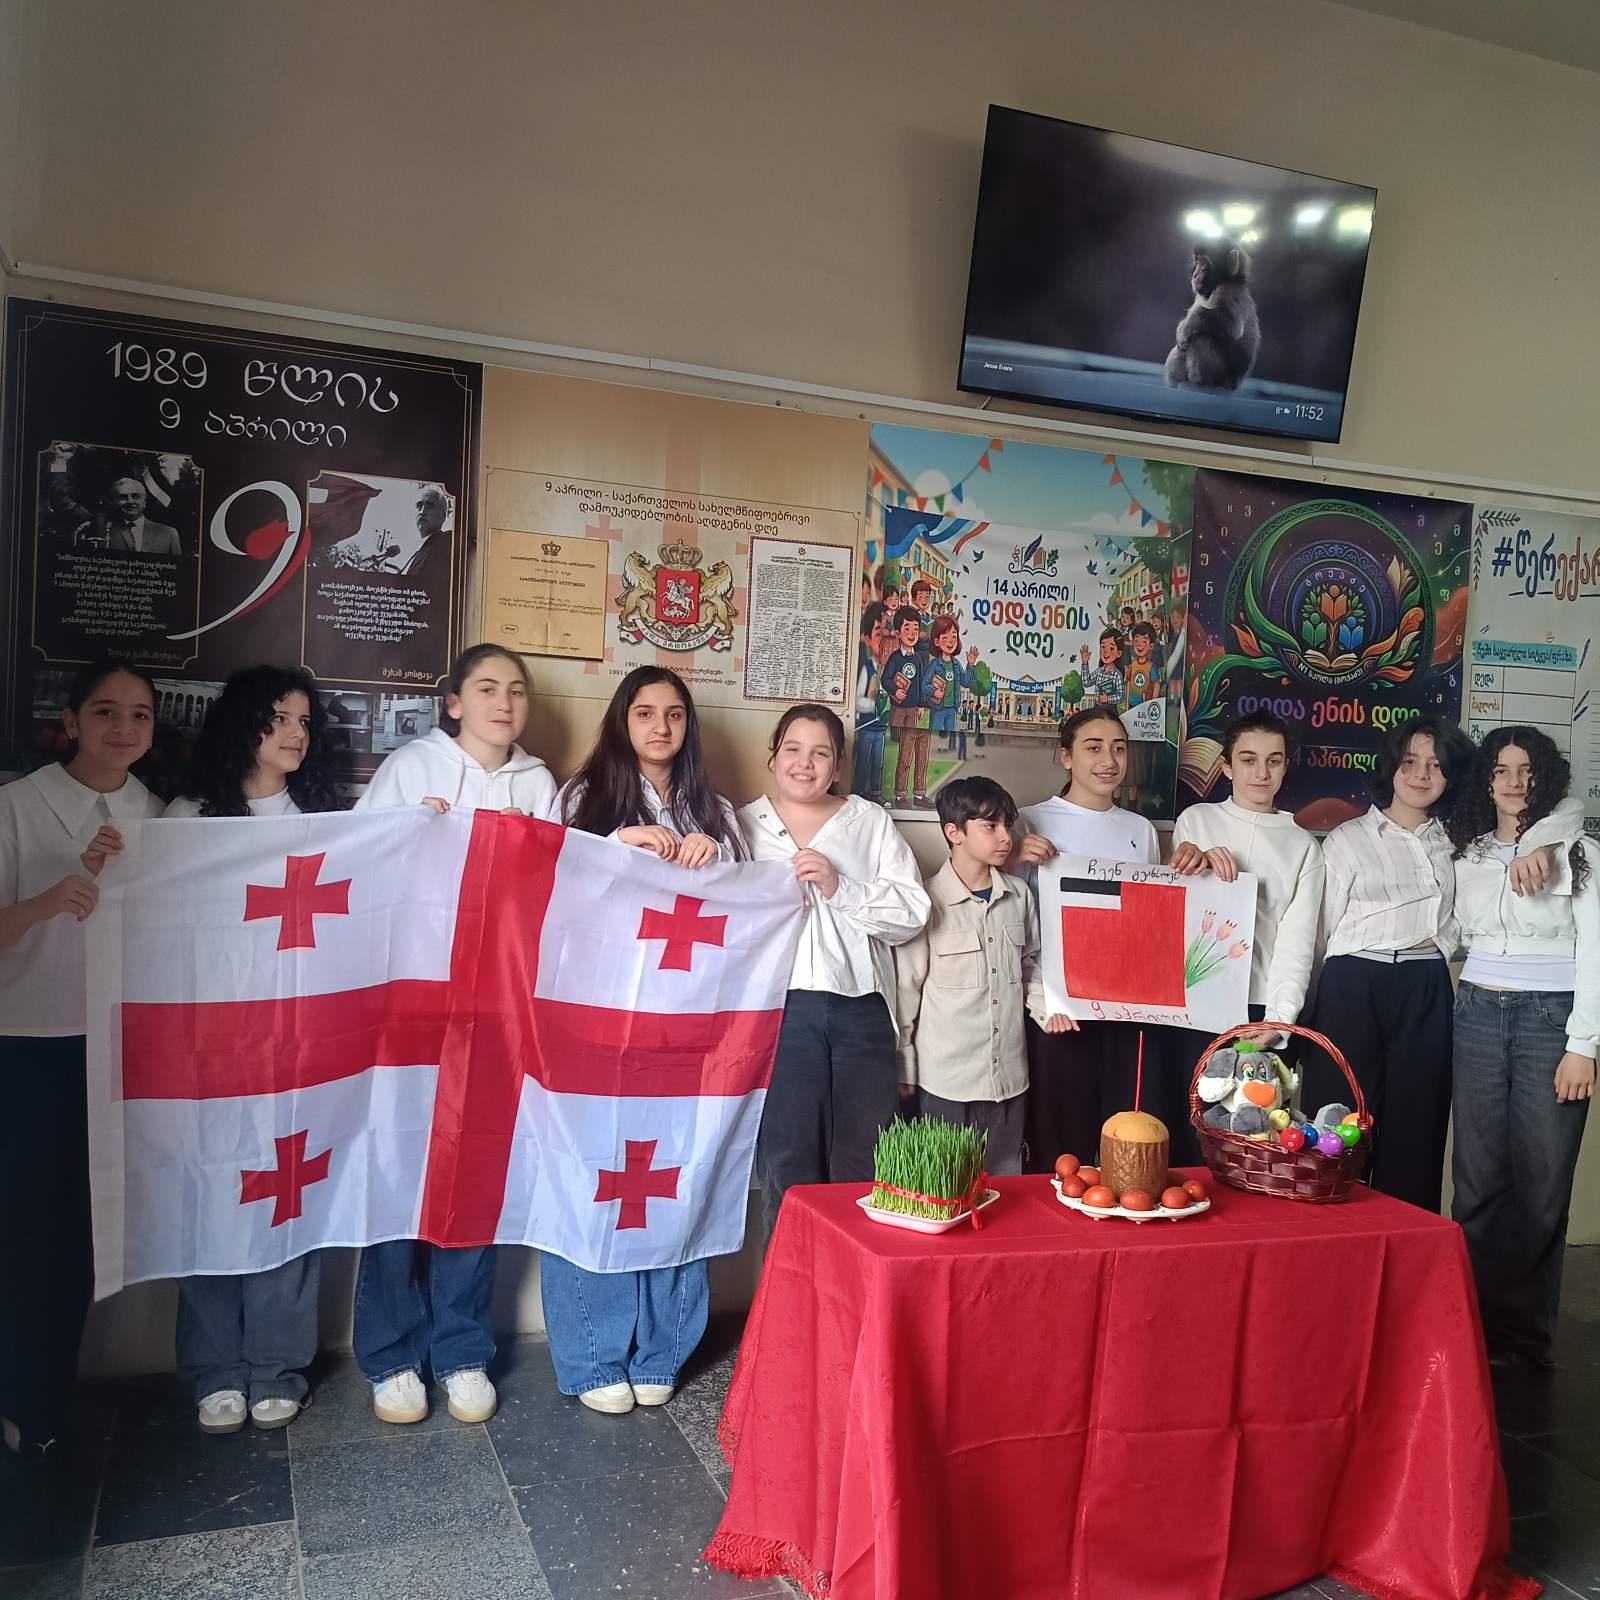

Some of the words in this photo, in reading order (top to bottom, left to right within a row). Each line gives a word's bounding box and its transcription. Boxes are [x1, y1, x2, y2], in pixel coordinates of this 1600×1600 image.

[105, 341, 208, 389] 1989
[244, 359, 399, 413] წლის
[158, 398, 181, 429] 9
[204, 410, 348, 448] აპრილი
[1296, 404, 1324, 421] 11:52
[545, 482, 552, 492] 9
[555, 484, 602, 500] აპრილი
[612, 490, 696, 511] საქართველოს
[698, 500, 810, 525] სახელმწიფოებრივი
[578, 502, 694, 524] დამოუკიდებლობის
[696, 516, 752, 533] აღდგენის
[754, 522, 779, 536] დღე
[992, 578, 1009, 596] 14
[1012, 581, 1069, 602] აპრილი
[972, 598, 1037, 628] დედა
[1040, 604, 1090, 631] ენის
[1006, 630, 1055, 659] დღე
[1311, 696, 1366, 728] ენის
[1088, 859, 1126, 881] ჩვენ
[1092, 1001, 1106, 1019] 9
